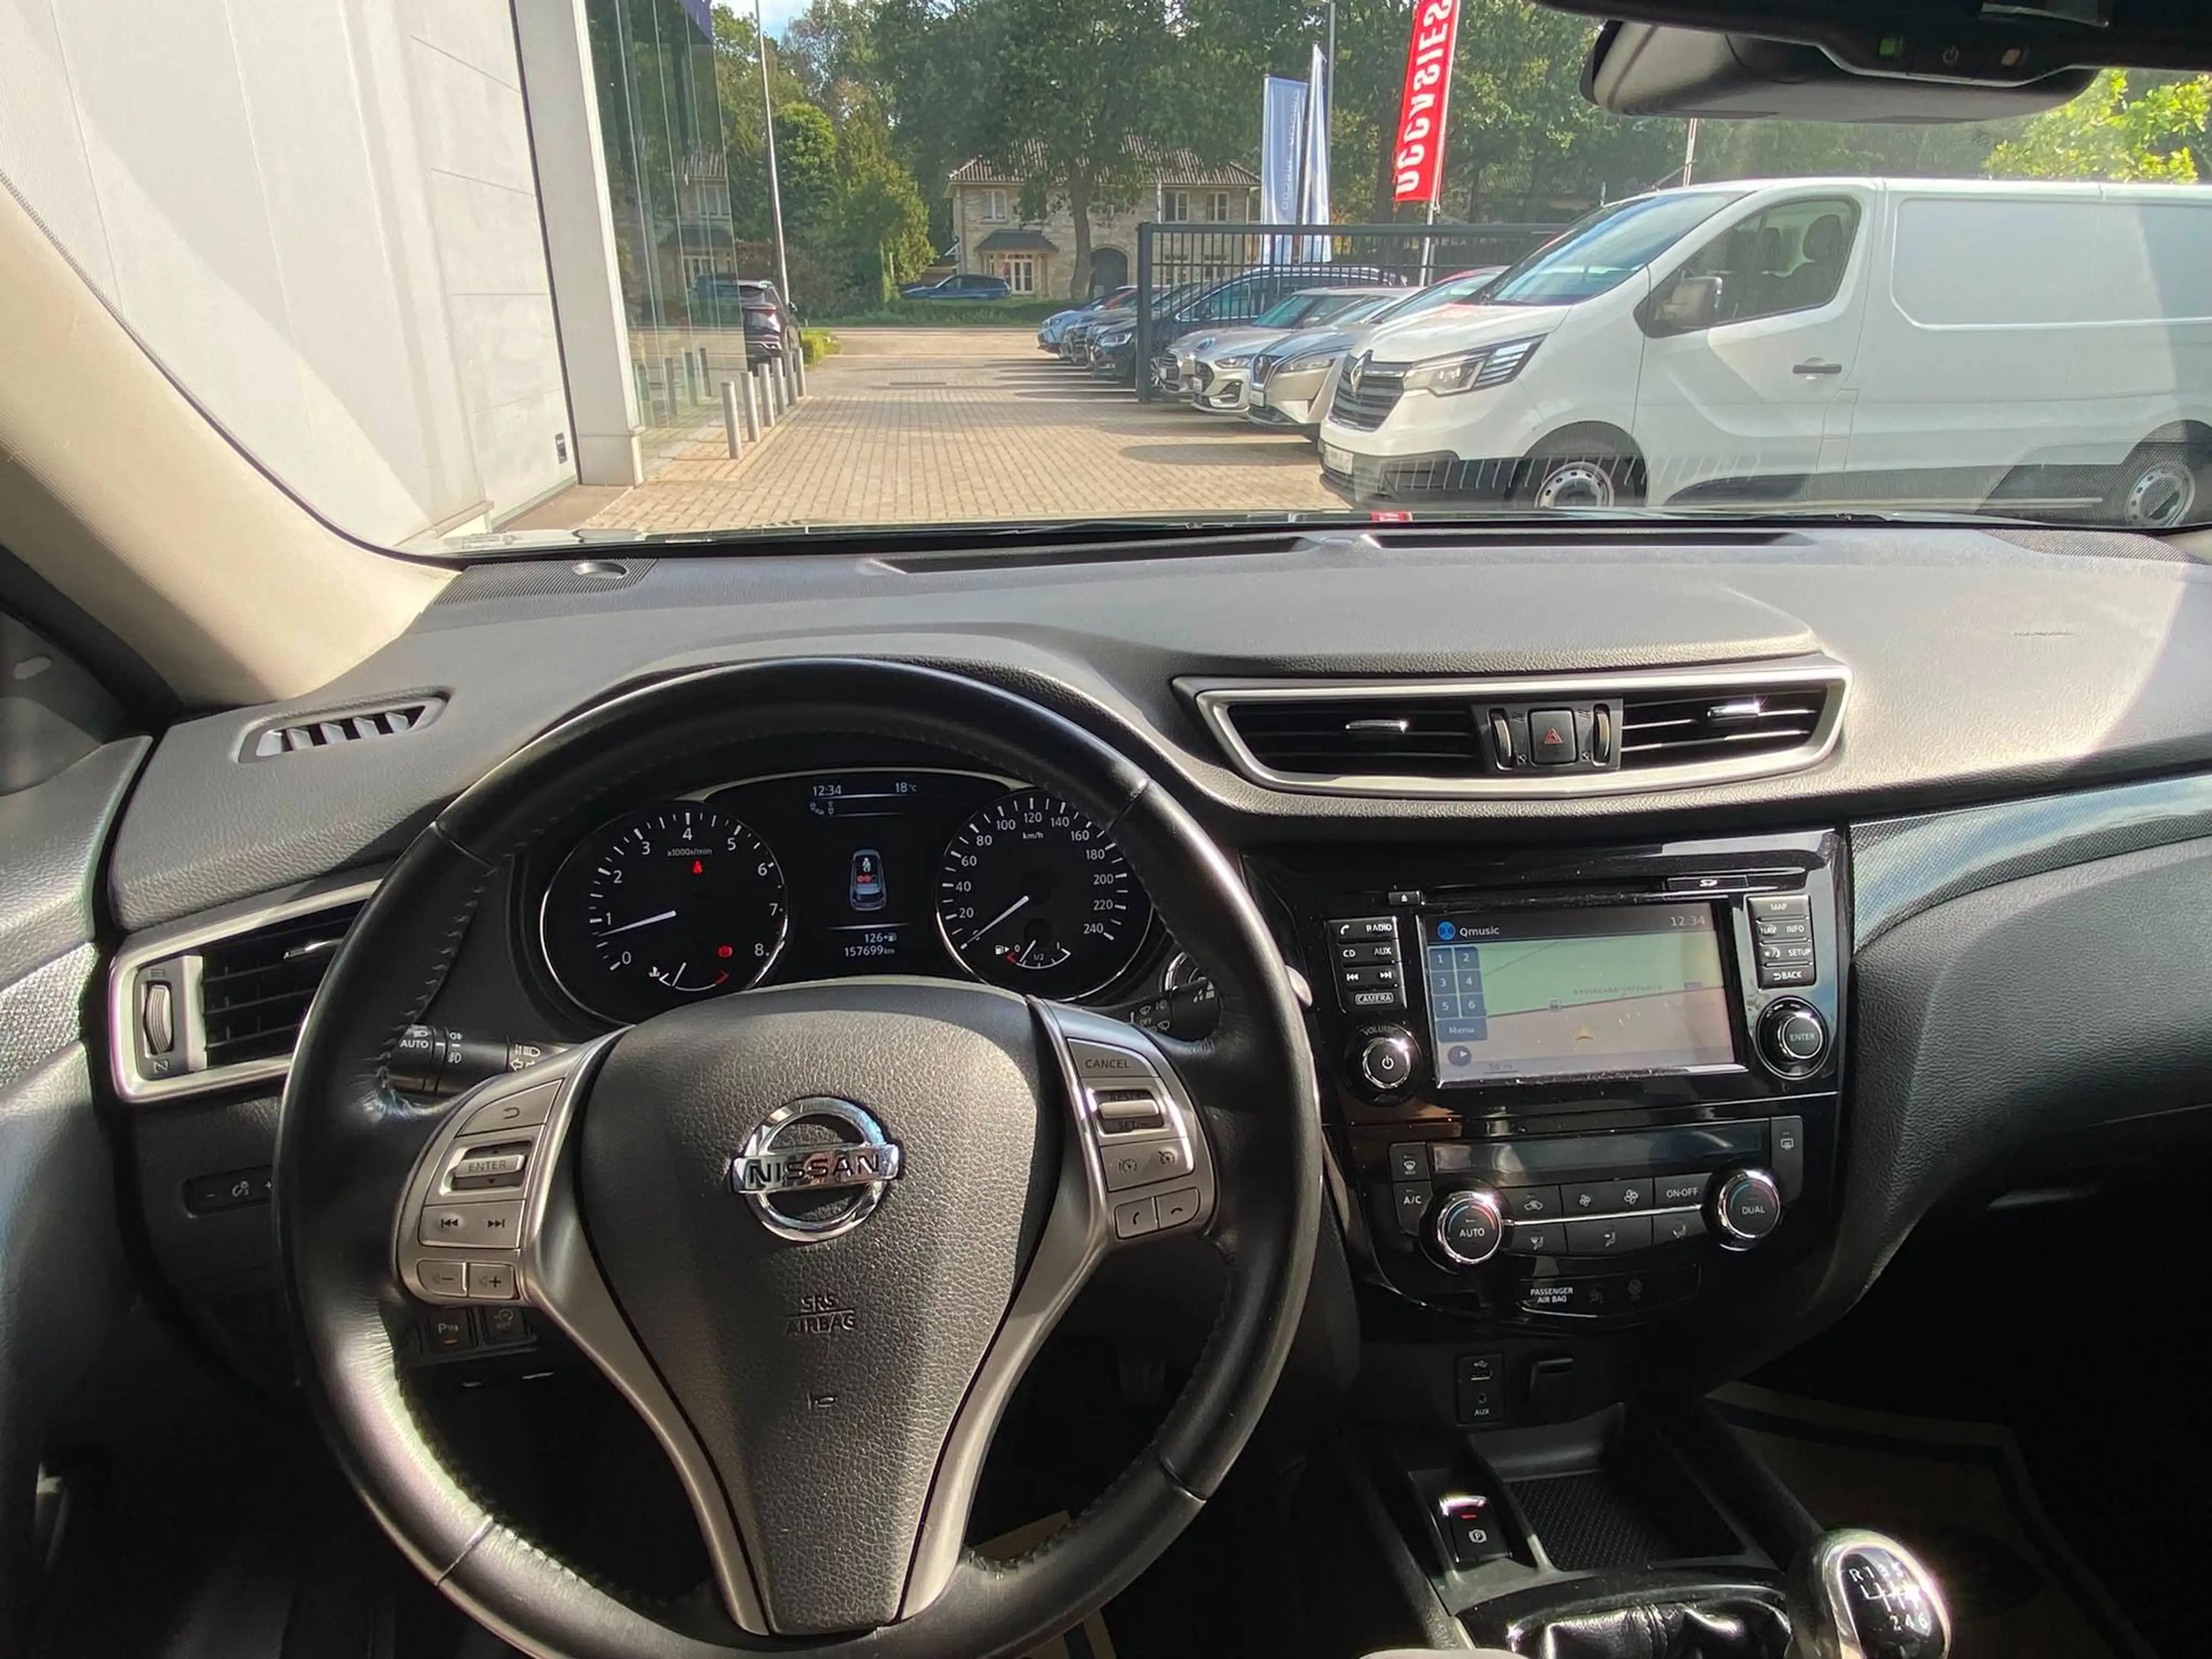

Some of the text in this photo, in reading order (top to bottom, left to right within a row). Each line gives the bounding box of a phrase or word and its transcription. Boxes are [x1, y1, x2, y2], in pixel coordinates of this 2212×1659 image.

[813, 785, 842, 796] 12:34
[1024, 812, 1042, 823] 120
[1051, 816, 1070, 828] 140
[996, 819, 1016, 831] 100
[683, 828, 692, 840] 4
[1071, 830, 1090, 842] 160
[727, 838, 737, 851] 5
[976, 835, 993, 846] 80
[642, 842, 650, 855] 3
[1086, 849, 1105, 860] 180
[961, 855, 977, 866] 60
[757, 863, 767, 876] 6
[613, 870, 623, 884] 2
[1093, 873, 1114, 885] 200
[956, 881, 972, 892] 40
[769, 903, 778, 916] 7
[1093, 899, 1113, 911] 220
[1770, 903, 1787, 911] MAP
[606, 912, 611, 925] 1
[959, 907, 974, 919] 20
[1083, 923, 1104, 934] 240
[1366, 924, 1392, 932] RADIO
[1459, 926, 1499, 937] Qmusic
[1786, 925, 1805, 933] INFO
[865, 933, 883, 943] 126
[754, 943, 764, 956] 8
[844, 945, 884, 957] 157699
[1014, 944, 1021, 952] 0
[1343, 946, 1392, 957] CD AUX
[622, 952, 631, 964] 0
[1438, 954, 1444, 964] 1
[1463, 953, 1470, 962] 2
[1781, 971, 1802, 979] BACK
[1440, 978, 1446, 987] 3
[1466, 976, 1473, 986] 4
[1357, 994, 1392, 1003] CAMERA
[1442, 1001, 1449, 1011] 5
[1468, 1000, 1476, 1009] 6
[1449, 1026, 1475, 1035] Menu
[1790, 1032, 1815, 1042] ENTER
[400, 1040, 429, 1049] AUTO
[1085, 1059, 1131, 1070] CANCEL
[468, 1160, 507, 1172] ENTER
[751, 1154, 880, 1183] NISSAN
[1404, 1195, 1422, 1205] A/C
[1742, 1206, 1766, 1214] DUAL
[1459, 1228, 1486, 1237] AUTO
[1530, 1287, 1573, 1296] PASSENGER
[1552, 1295, 1567, 1303] BAG
[801, 1297, 837, 1313] SRS
[786, 1312, 856, 1336] AIRBAG
[1849, 1568, 1863, 1582] R
[1863, 1566, 1874, 1578] 1
[1889, 1612, 1929, 1631] 2 4 6
